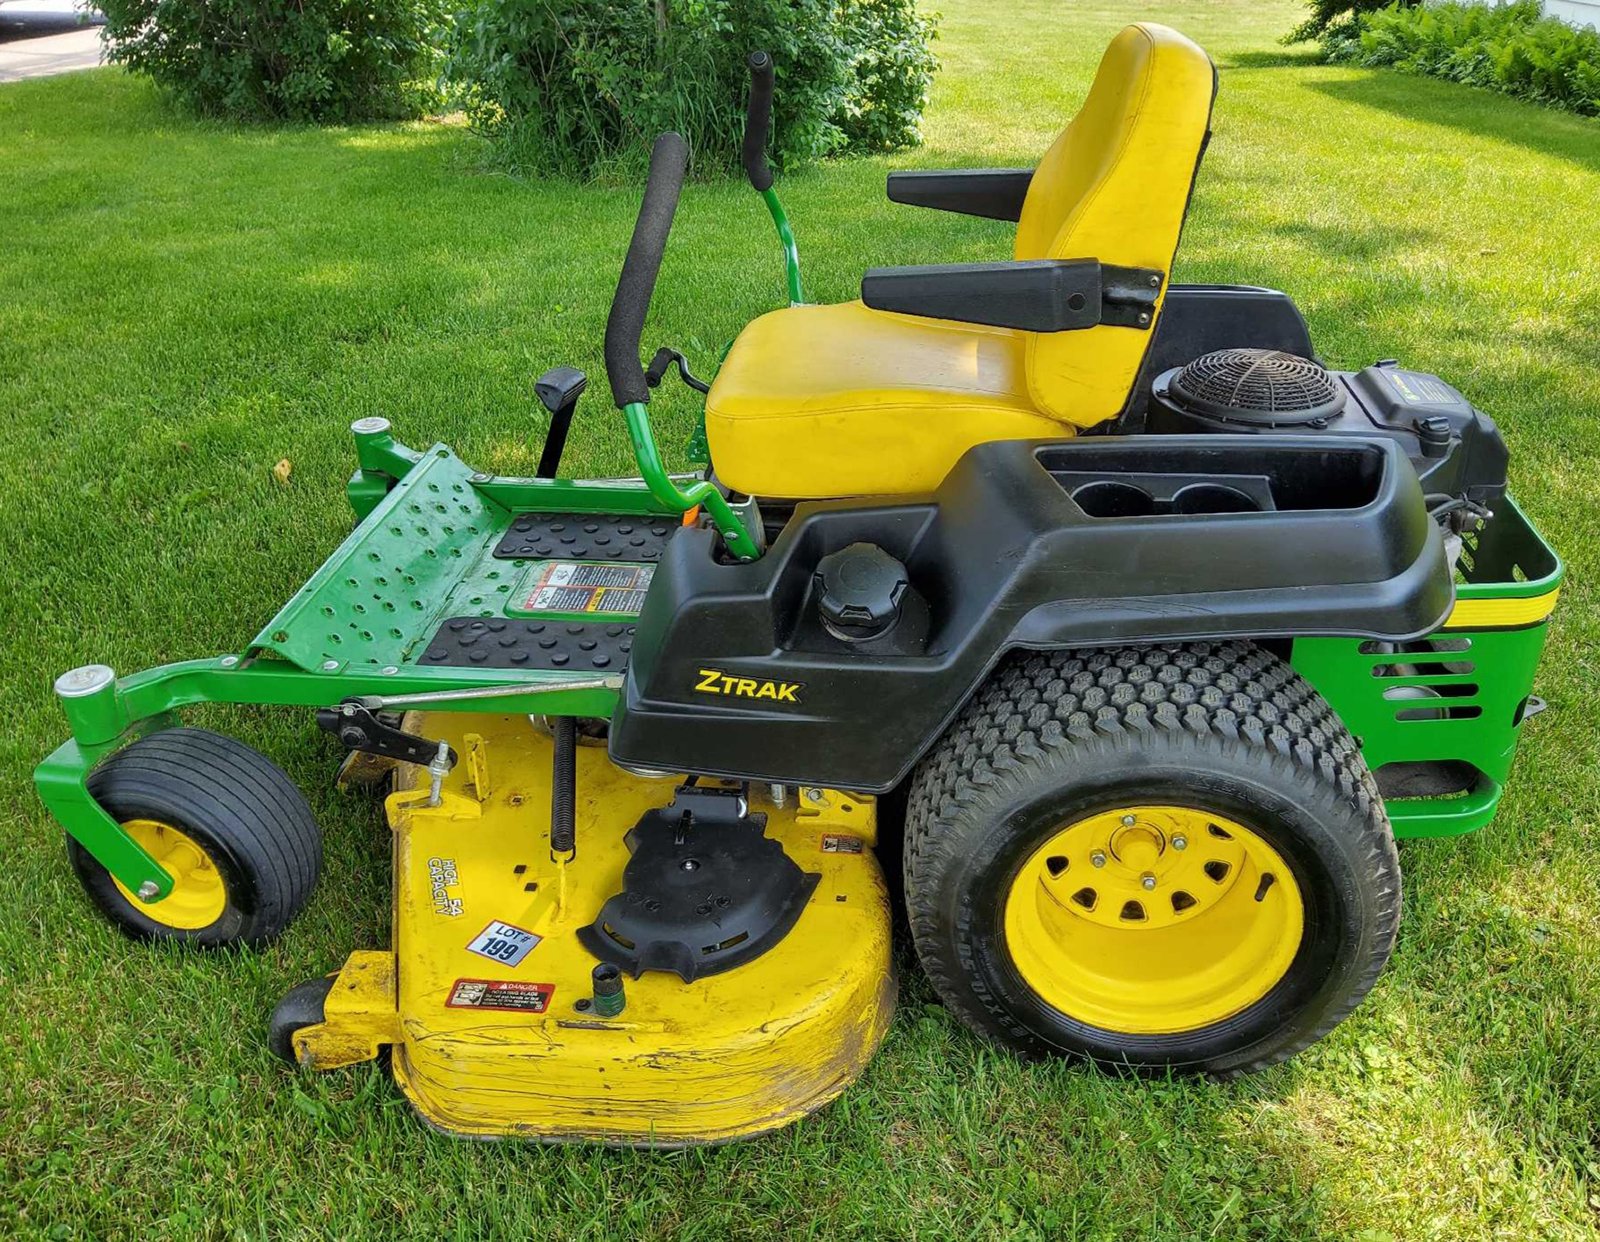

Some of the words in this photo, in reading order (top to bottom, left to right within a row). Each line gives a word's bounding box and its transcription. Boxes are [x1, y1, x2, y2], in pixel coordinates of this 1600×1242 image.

[695, 669, 800, 702] ZTRAK
[442, 858, 459, 886] HIGH
[428, 856, 451, 915] CAPACITY
[449, 898, 464, 916] 54
[495, 925, 524, 940] LOT
[520, 935, 533, 944] #
[480, 937, 519, 961] 199
